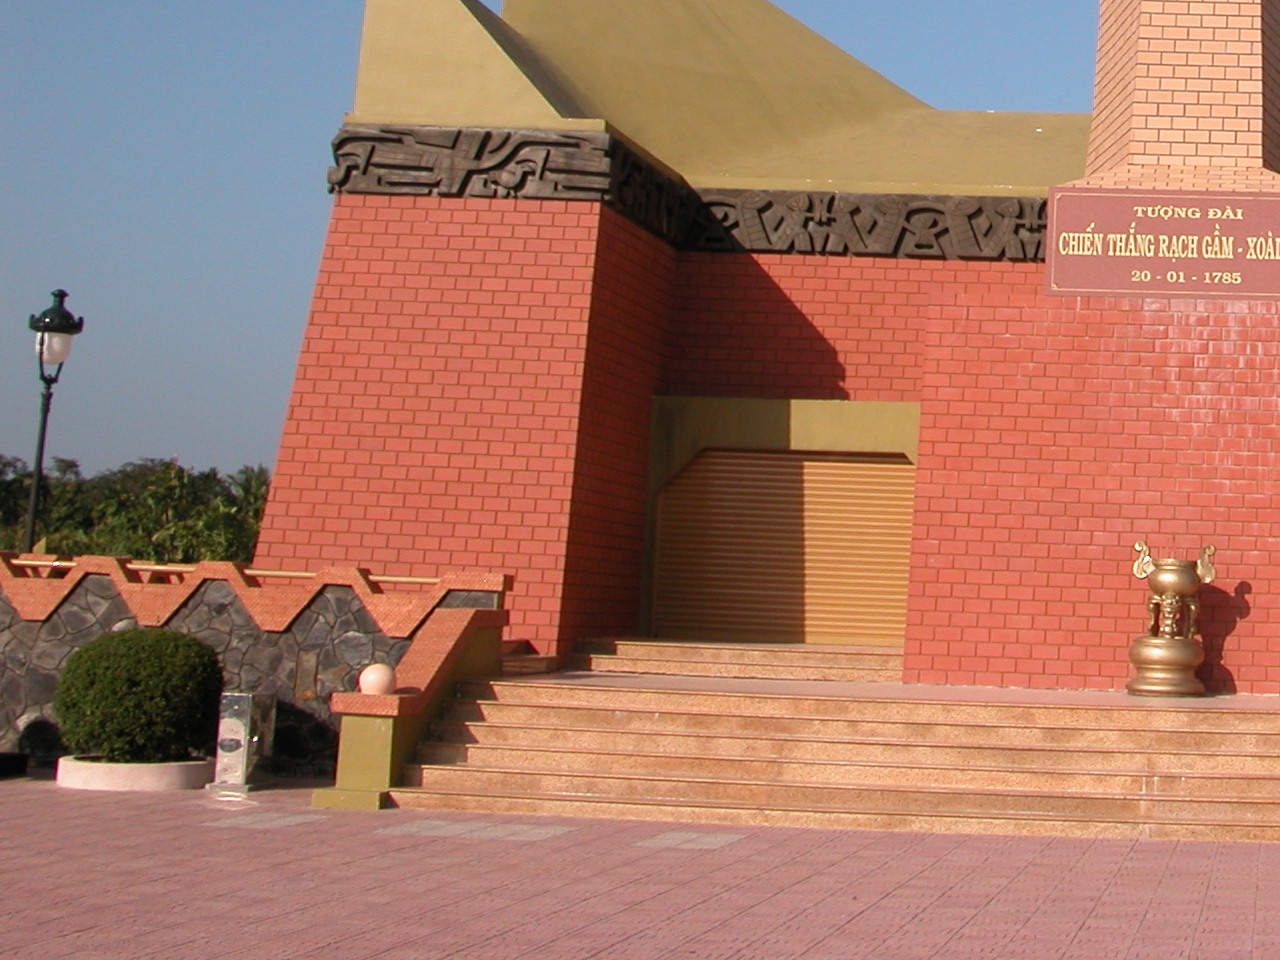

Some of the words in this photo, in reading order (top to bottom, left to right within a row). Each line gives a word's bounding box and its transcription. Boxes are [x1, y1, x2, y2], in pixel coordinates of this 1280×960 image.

[1133, 205, 1202, 220] TƯỢNG
[1207, 205, 1244, 220] ĐÀI
[1059, 222, 1104, 255] CHIẾN
[1106, 221, 1155, 257] THẮNG
[1158, 235, 1199, 263] RẠCH
[1202, 223, 1235, 259] GẦM
[1246, 230, 1280, 260] XOÀI
[1131, 270, 1151, 281] 20
[1166, 271, 1186, 283] 01
[1203, 272, 1242, 284] 1785
